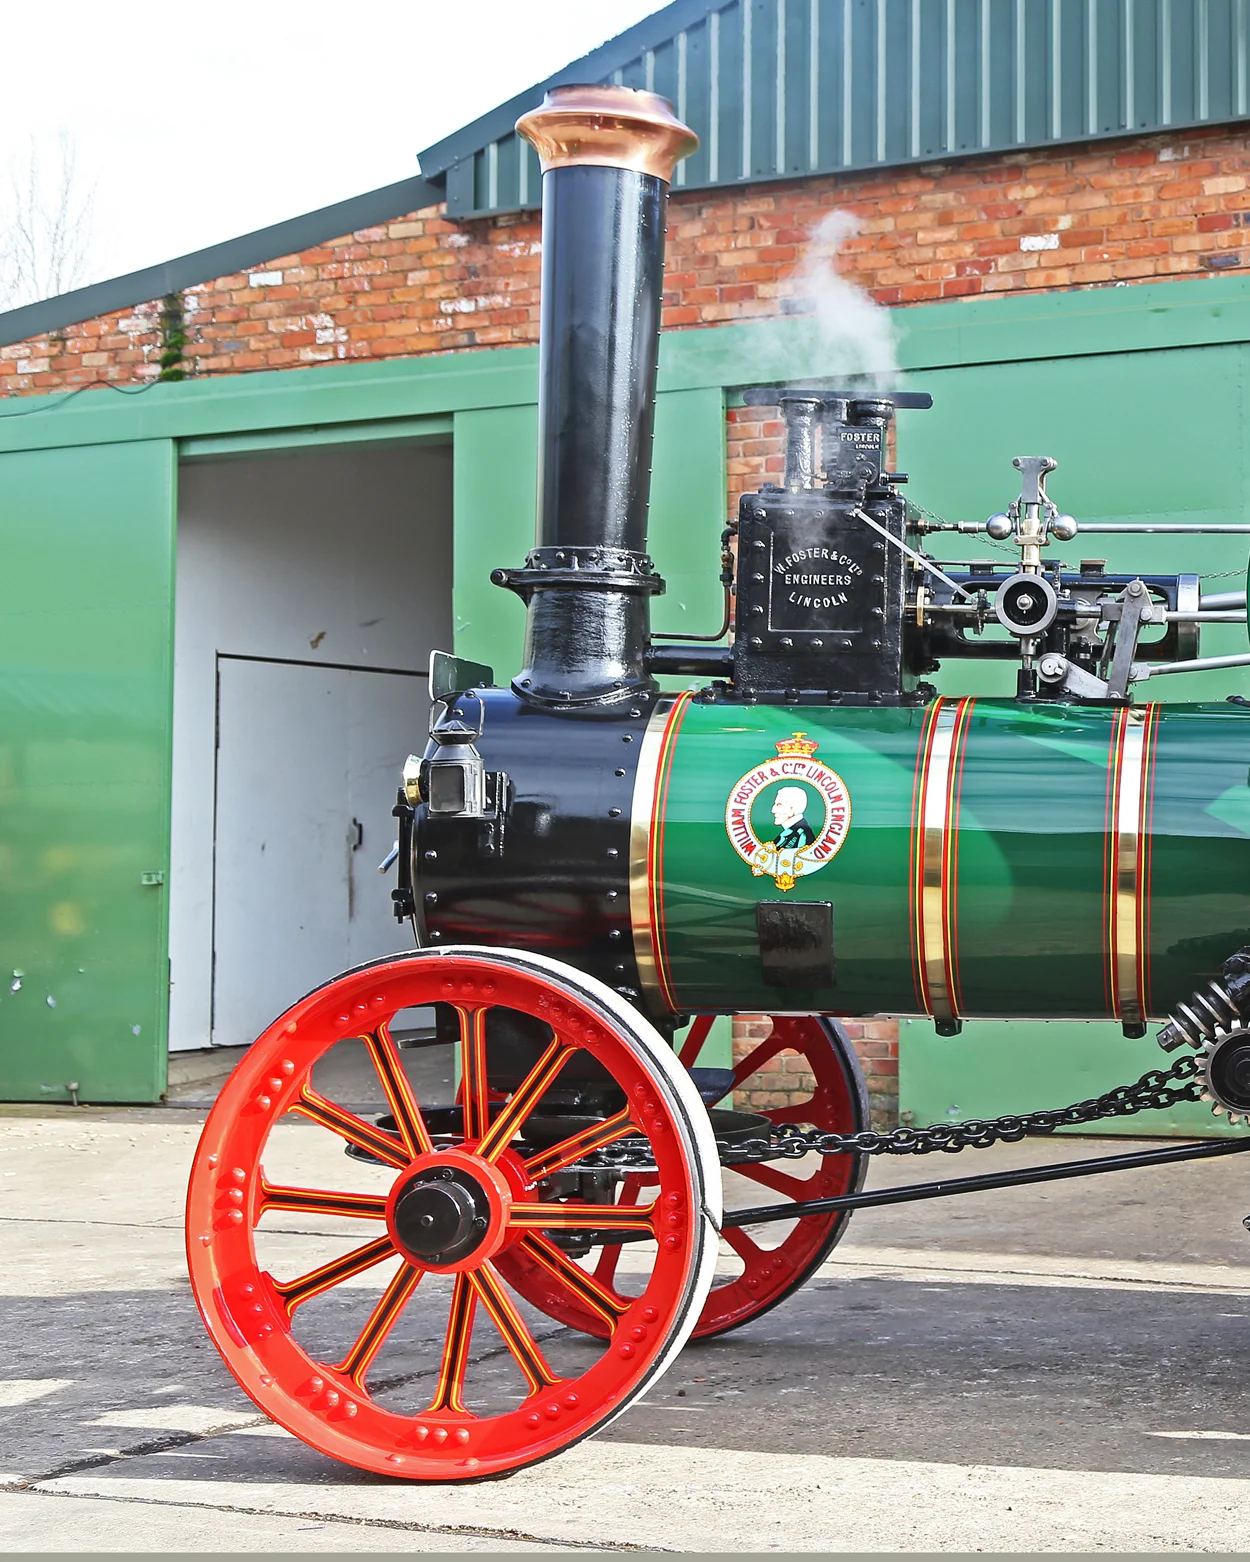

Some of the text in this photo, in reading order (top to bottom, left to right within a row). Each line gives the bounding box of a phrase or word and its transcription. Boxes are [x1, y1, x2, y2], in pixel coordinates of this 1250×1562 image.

[841, 432, 880, 442] FOSTER
[785, 574, 852, 586] ENGINEERS
[788, 591, 848, 609] LINCOLN
[769, 767, 781, 777] &
[806, 765, 844, 804] LINCOLN
[734, 770, 769, 806] FOSTER
[731, 808, 758, 857] WILLIAM
[813, 806, 846, 860] ENGLAND
